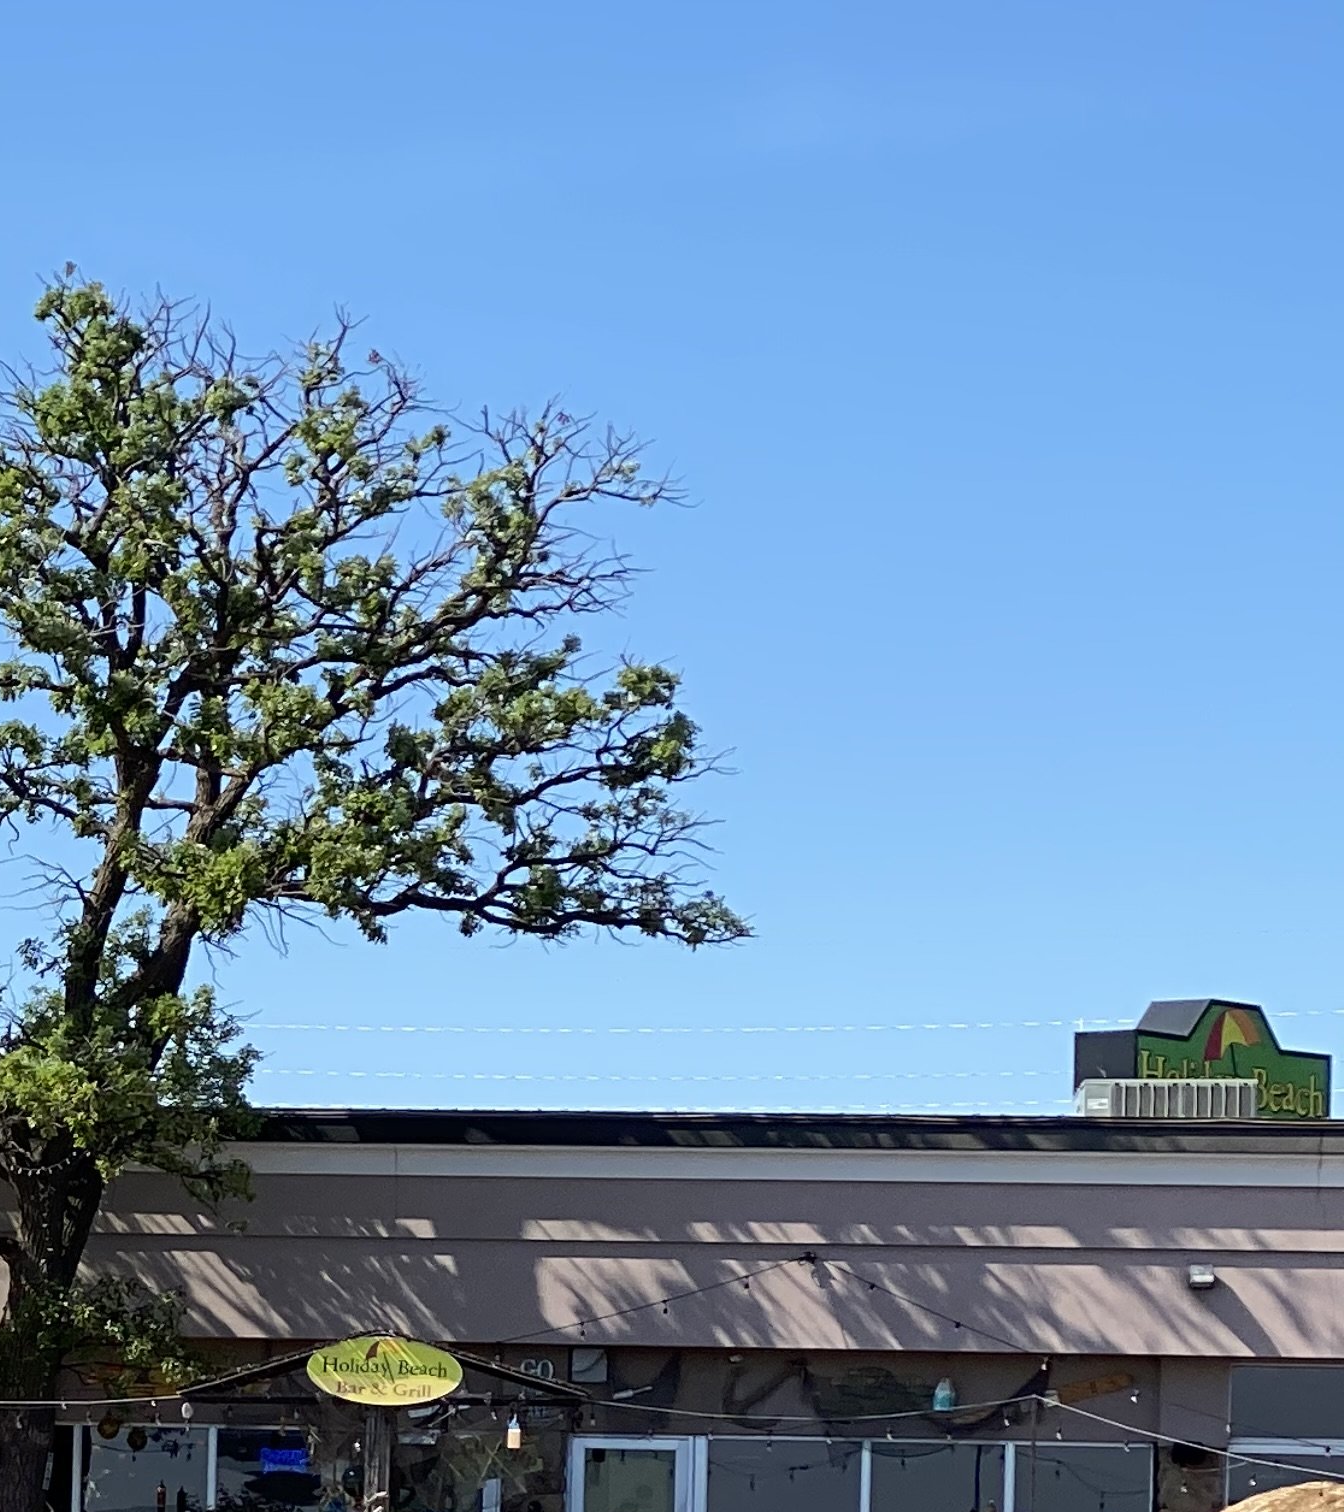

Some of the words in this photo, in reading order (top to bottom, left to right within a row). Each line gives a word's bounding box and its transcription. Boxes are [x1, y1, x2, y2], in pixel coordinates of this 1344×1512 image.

[1251, 1066, 1324, 1118] Beach
[322, 1356, 390, 1378] Holiday
[398, 1359, 448, 1379] Beach
[336, 1381, 367, 1395] Bar
[370, 1382, 386, 1396] &
[393, 1383, 432, 1398] Grill
